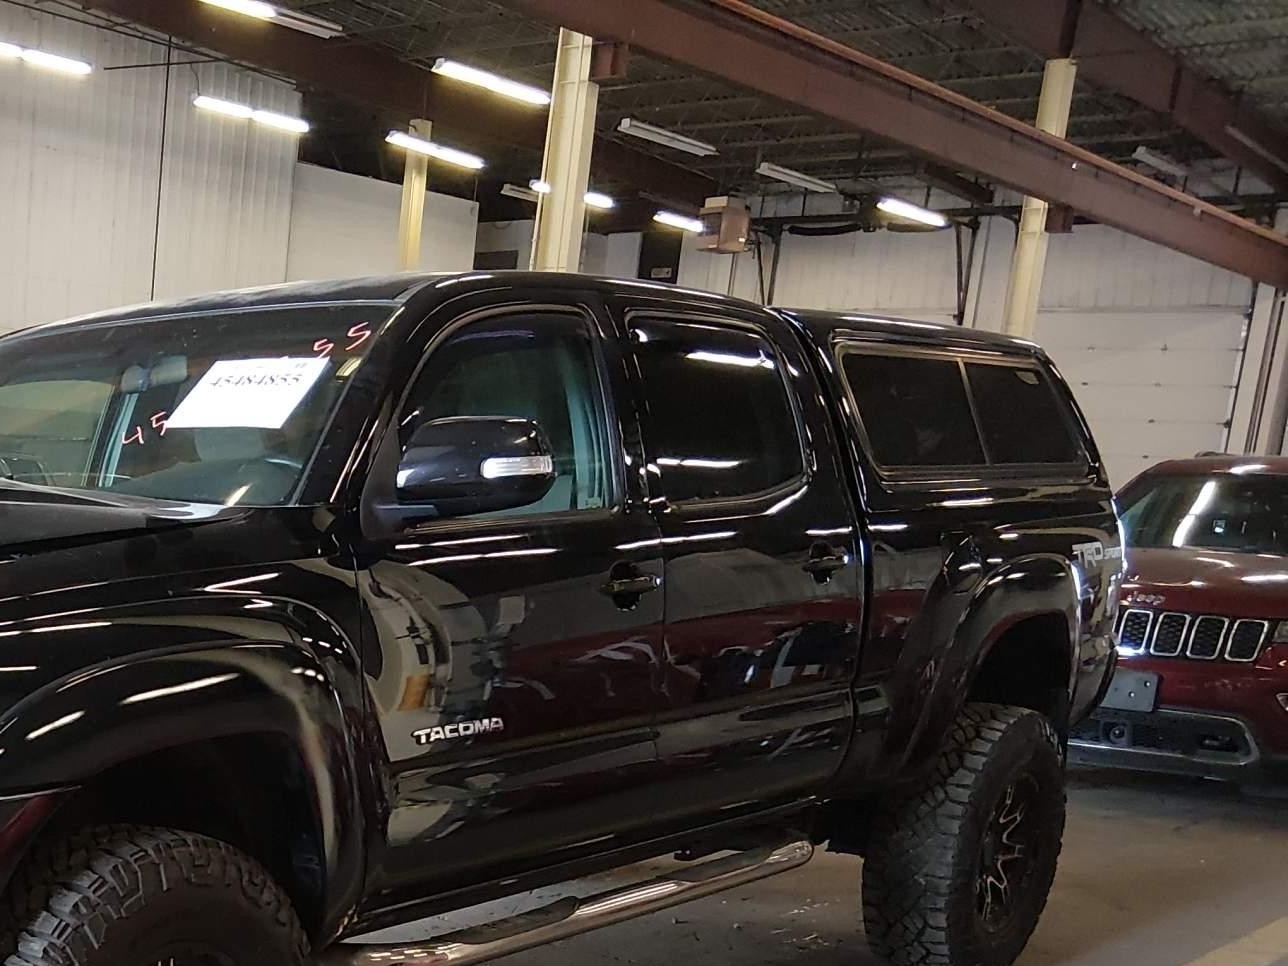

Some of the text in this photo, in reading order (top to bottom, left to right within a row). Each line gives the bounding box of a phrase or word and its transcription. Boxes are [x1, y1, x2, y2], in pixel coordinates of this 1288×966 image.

[1072, 541, 1104, 568] TRD
[1126, 590, 1166, 606] Jeep
[412, 716, 504, 745] TACOMA
